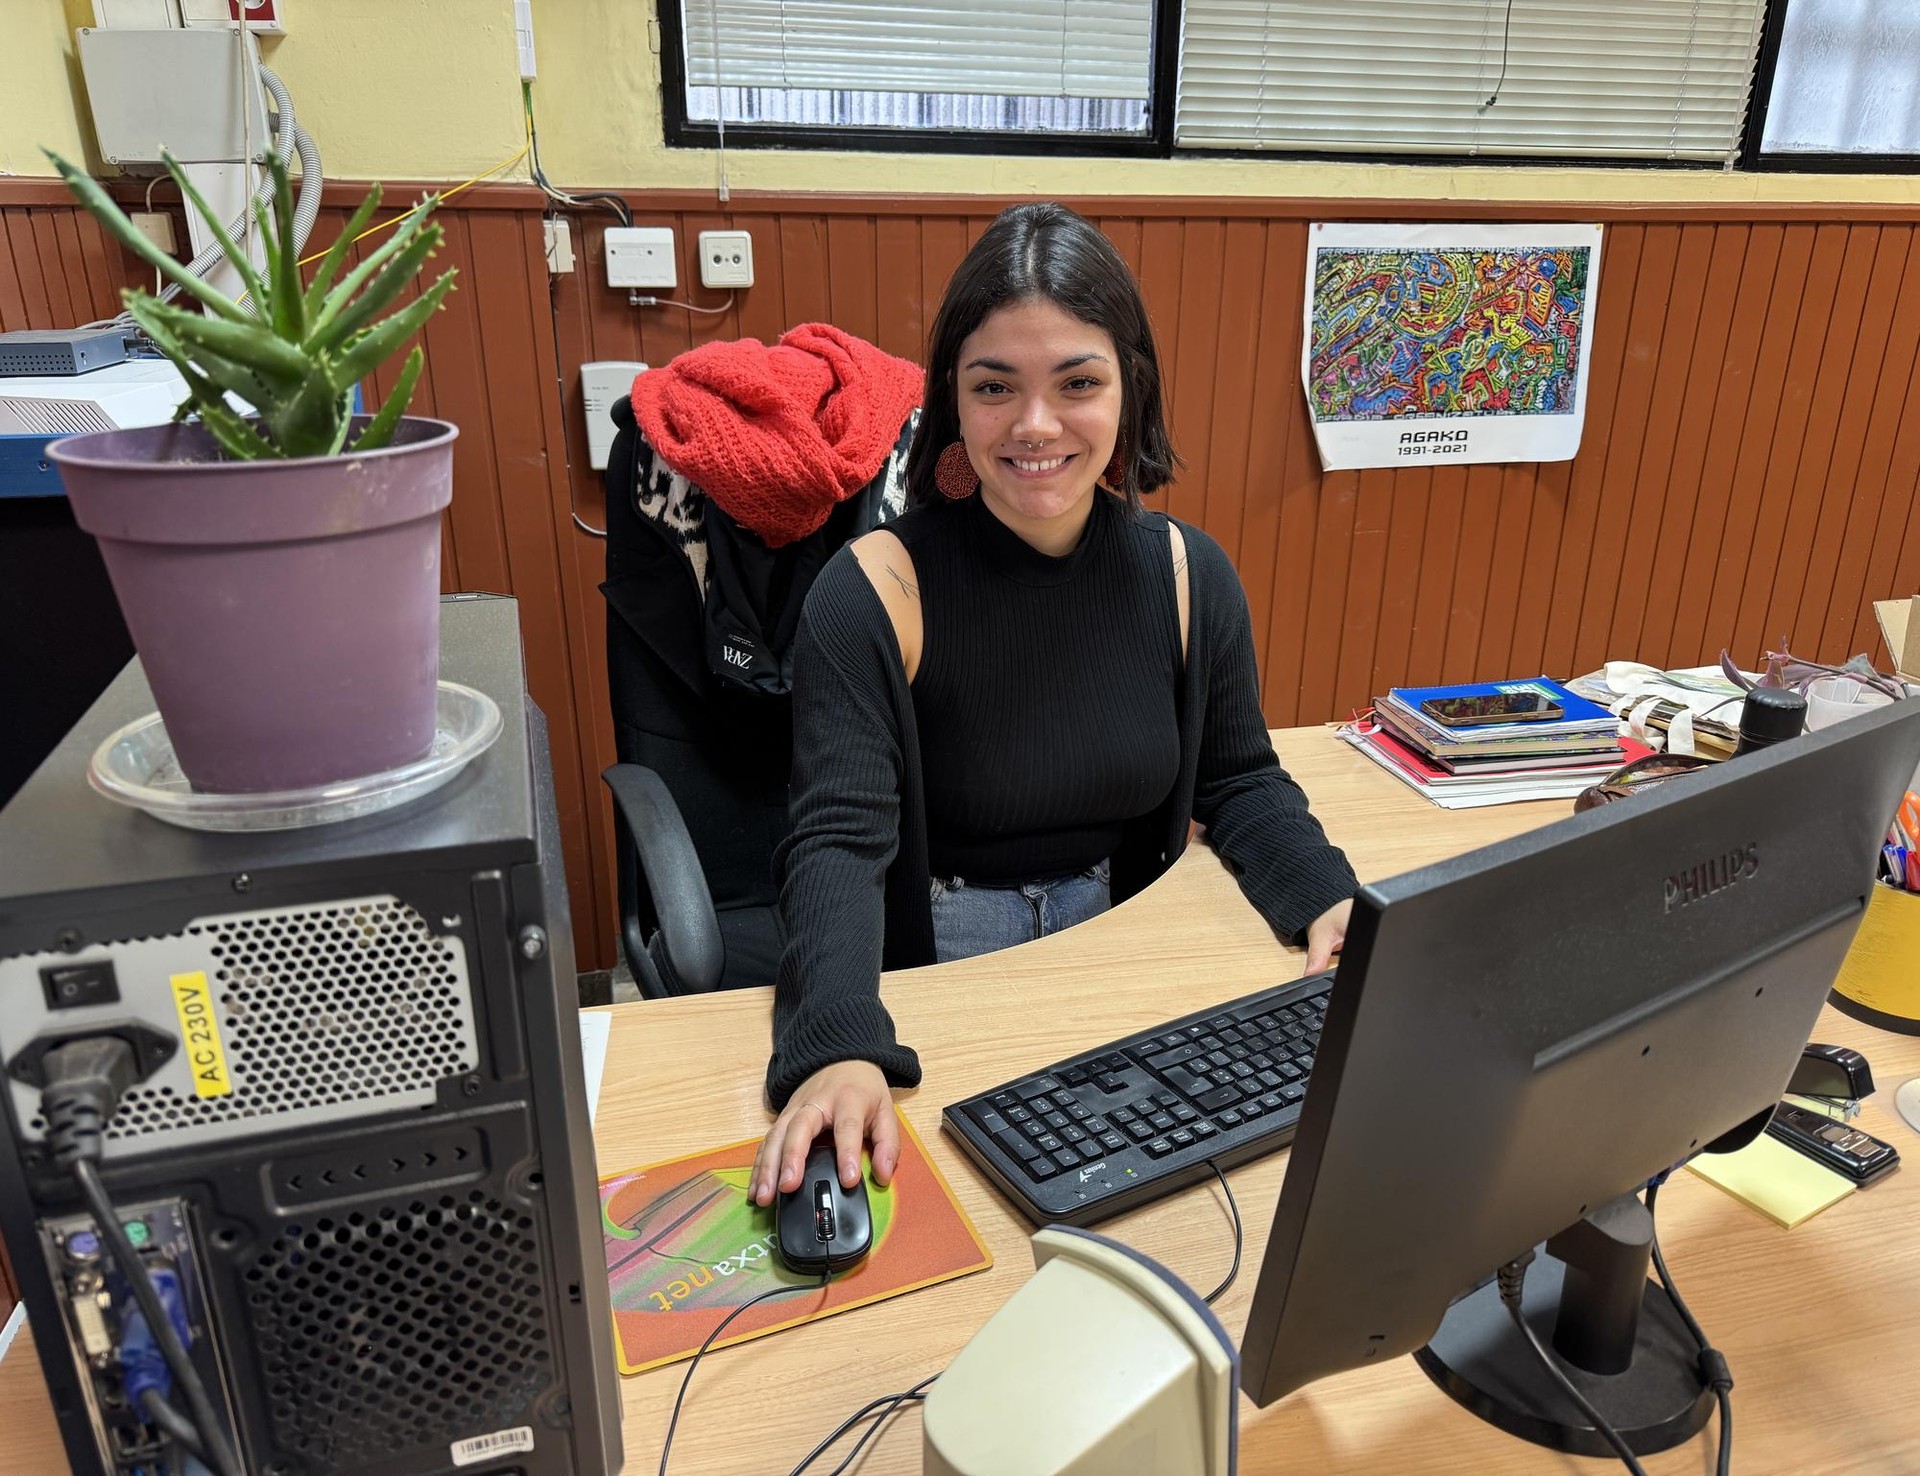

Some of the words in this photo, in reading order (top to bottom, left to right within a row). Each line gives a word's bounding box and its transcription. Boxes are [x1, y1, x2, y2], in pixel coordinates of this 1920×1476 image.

[1398, 444, 1467, 455] 1991-2021
[1400, 430, 1468, 443] AGAKO
[723, 645, 753, 669] ZARA
[1663, 841, 1759, 915] PHILIPS
[179, 986, 212, 1043] 230V
[195, 1050, 221, 1082] AC
[1084, 1162, 1106, 1175] Genius
[649, 1232, 778, 1312] utxanet
